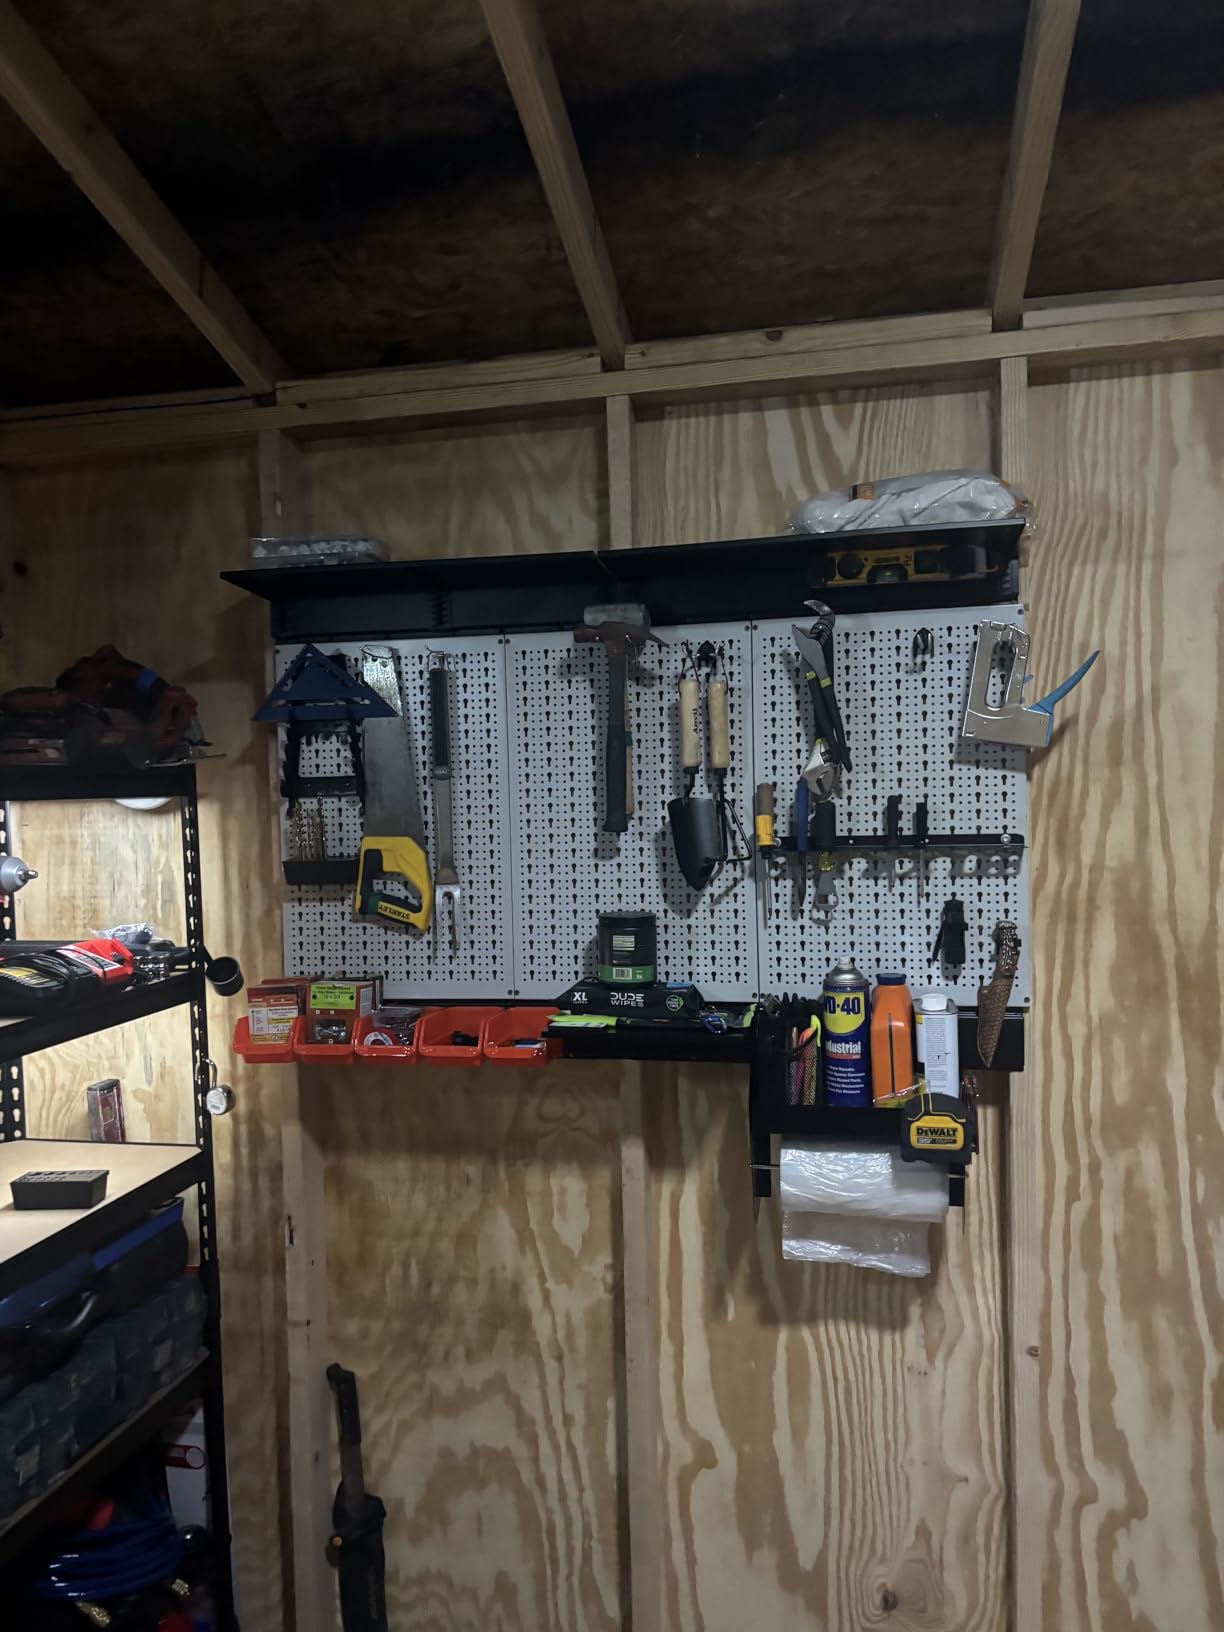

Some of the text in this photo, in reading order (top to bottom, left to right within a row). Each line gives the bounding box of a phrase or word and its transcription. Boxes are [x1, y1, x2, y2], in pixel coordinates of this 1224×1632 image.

[379, 904, 411, 919] STANLEY
[573, 991, 588, 1001] XL
[610, 992, 645, 1002] DUDE
[824, 995, 861, 1015] D-40
[916, 1127, 958, 1136] DEWALT
